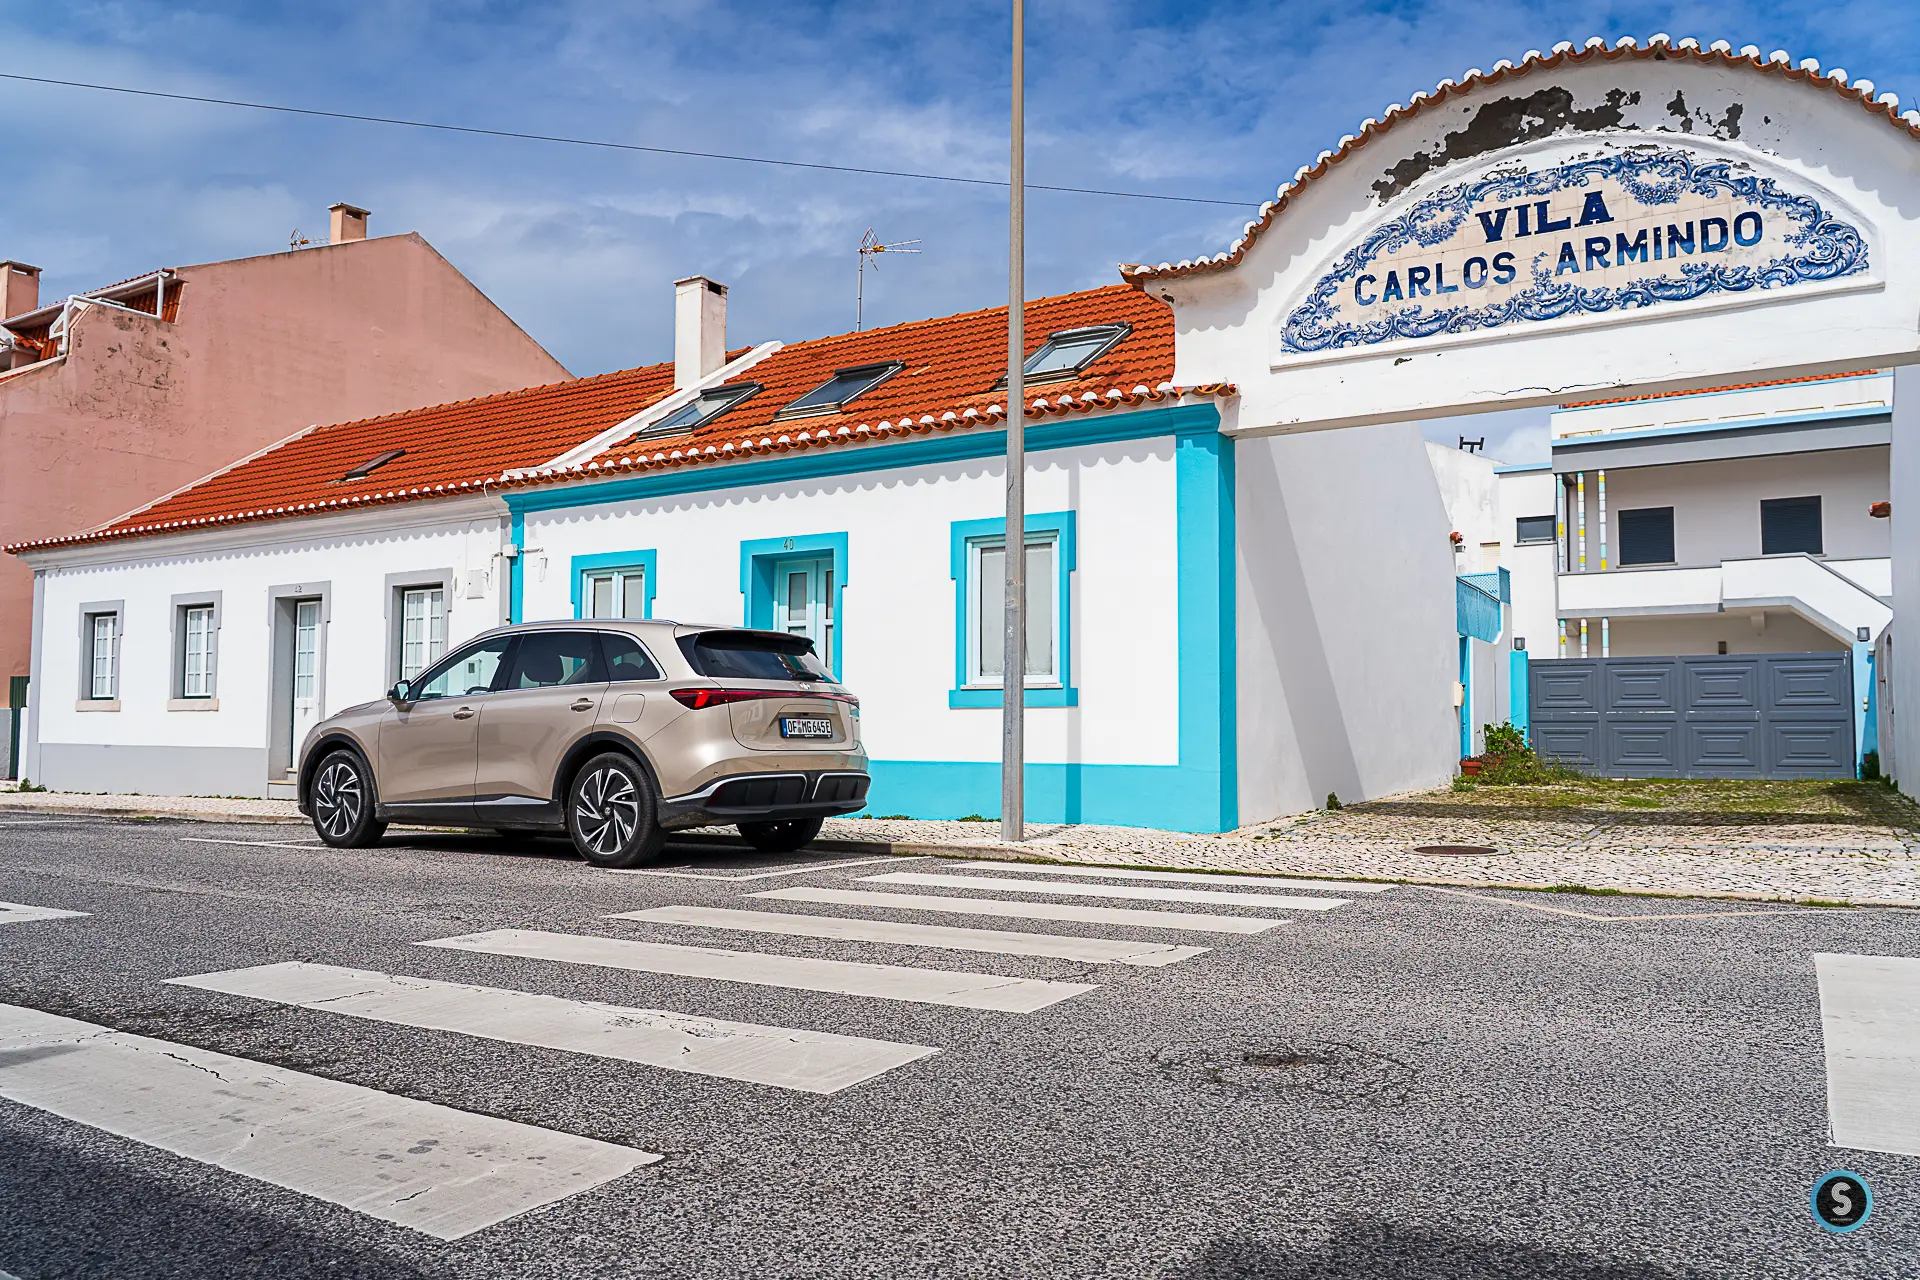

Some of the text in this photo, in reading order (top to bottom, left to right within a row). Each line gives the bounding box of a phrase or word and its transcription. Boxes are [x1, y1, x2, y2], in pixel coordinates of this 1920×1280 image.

[1475, 190, 1614, 244] VILA
[1354, 210, 1763, 307] CARLOS ARMINDO
[783, 538, 793, 550] 40
[787, 720, 797, 733] OF
